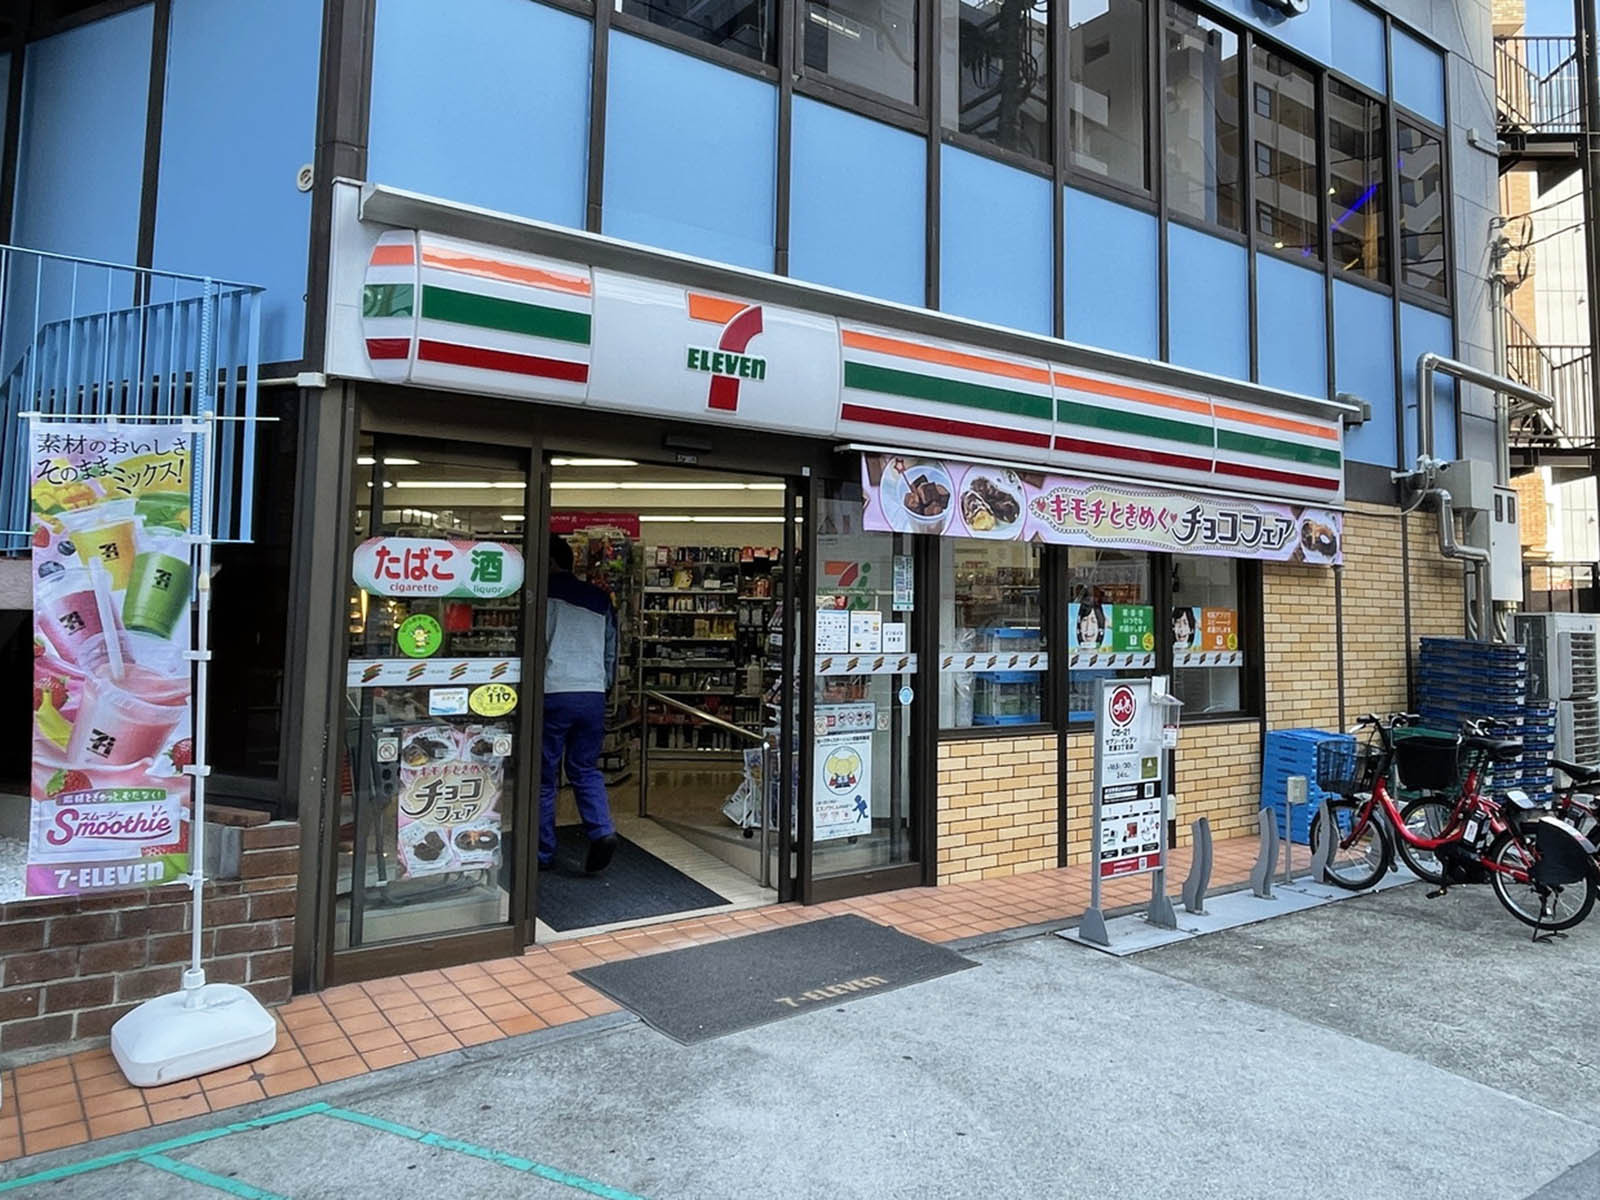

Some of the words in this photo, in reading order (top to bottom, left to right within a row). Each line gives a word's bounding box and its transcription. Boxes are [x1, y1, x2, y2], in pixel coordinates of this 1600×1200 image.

[37, 433, 187, 456] 素材のおいしさ
[1050, 494, 1168, 529] キモチときめく
[1171, 505, 1293, 546] チョコフェア
[374, 545, 455, 581] たばこ
[470, 549, 504, 583] 酒
[389, 583, 439, 593] cigarette
[473, 585, 504, 595] liquor
[401, 778, 483, 816] チョコ
[46, 807, 173, 846] Smoothie
[80, 811, 124, 821] スムージー
[434, 804, 479, 821] フェア
